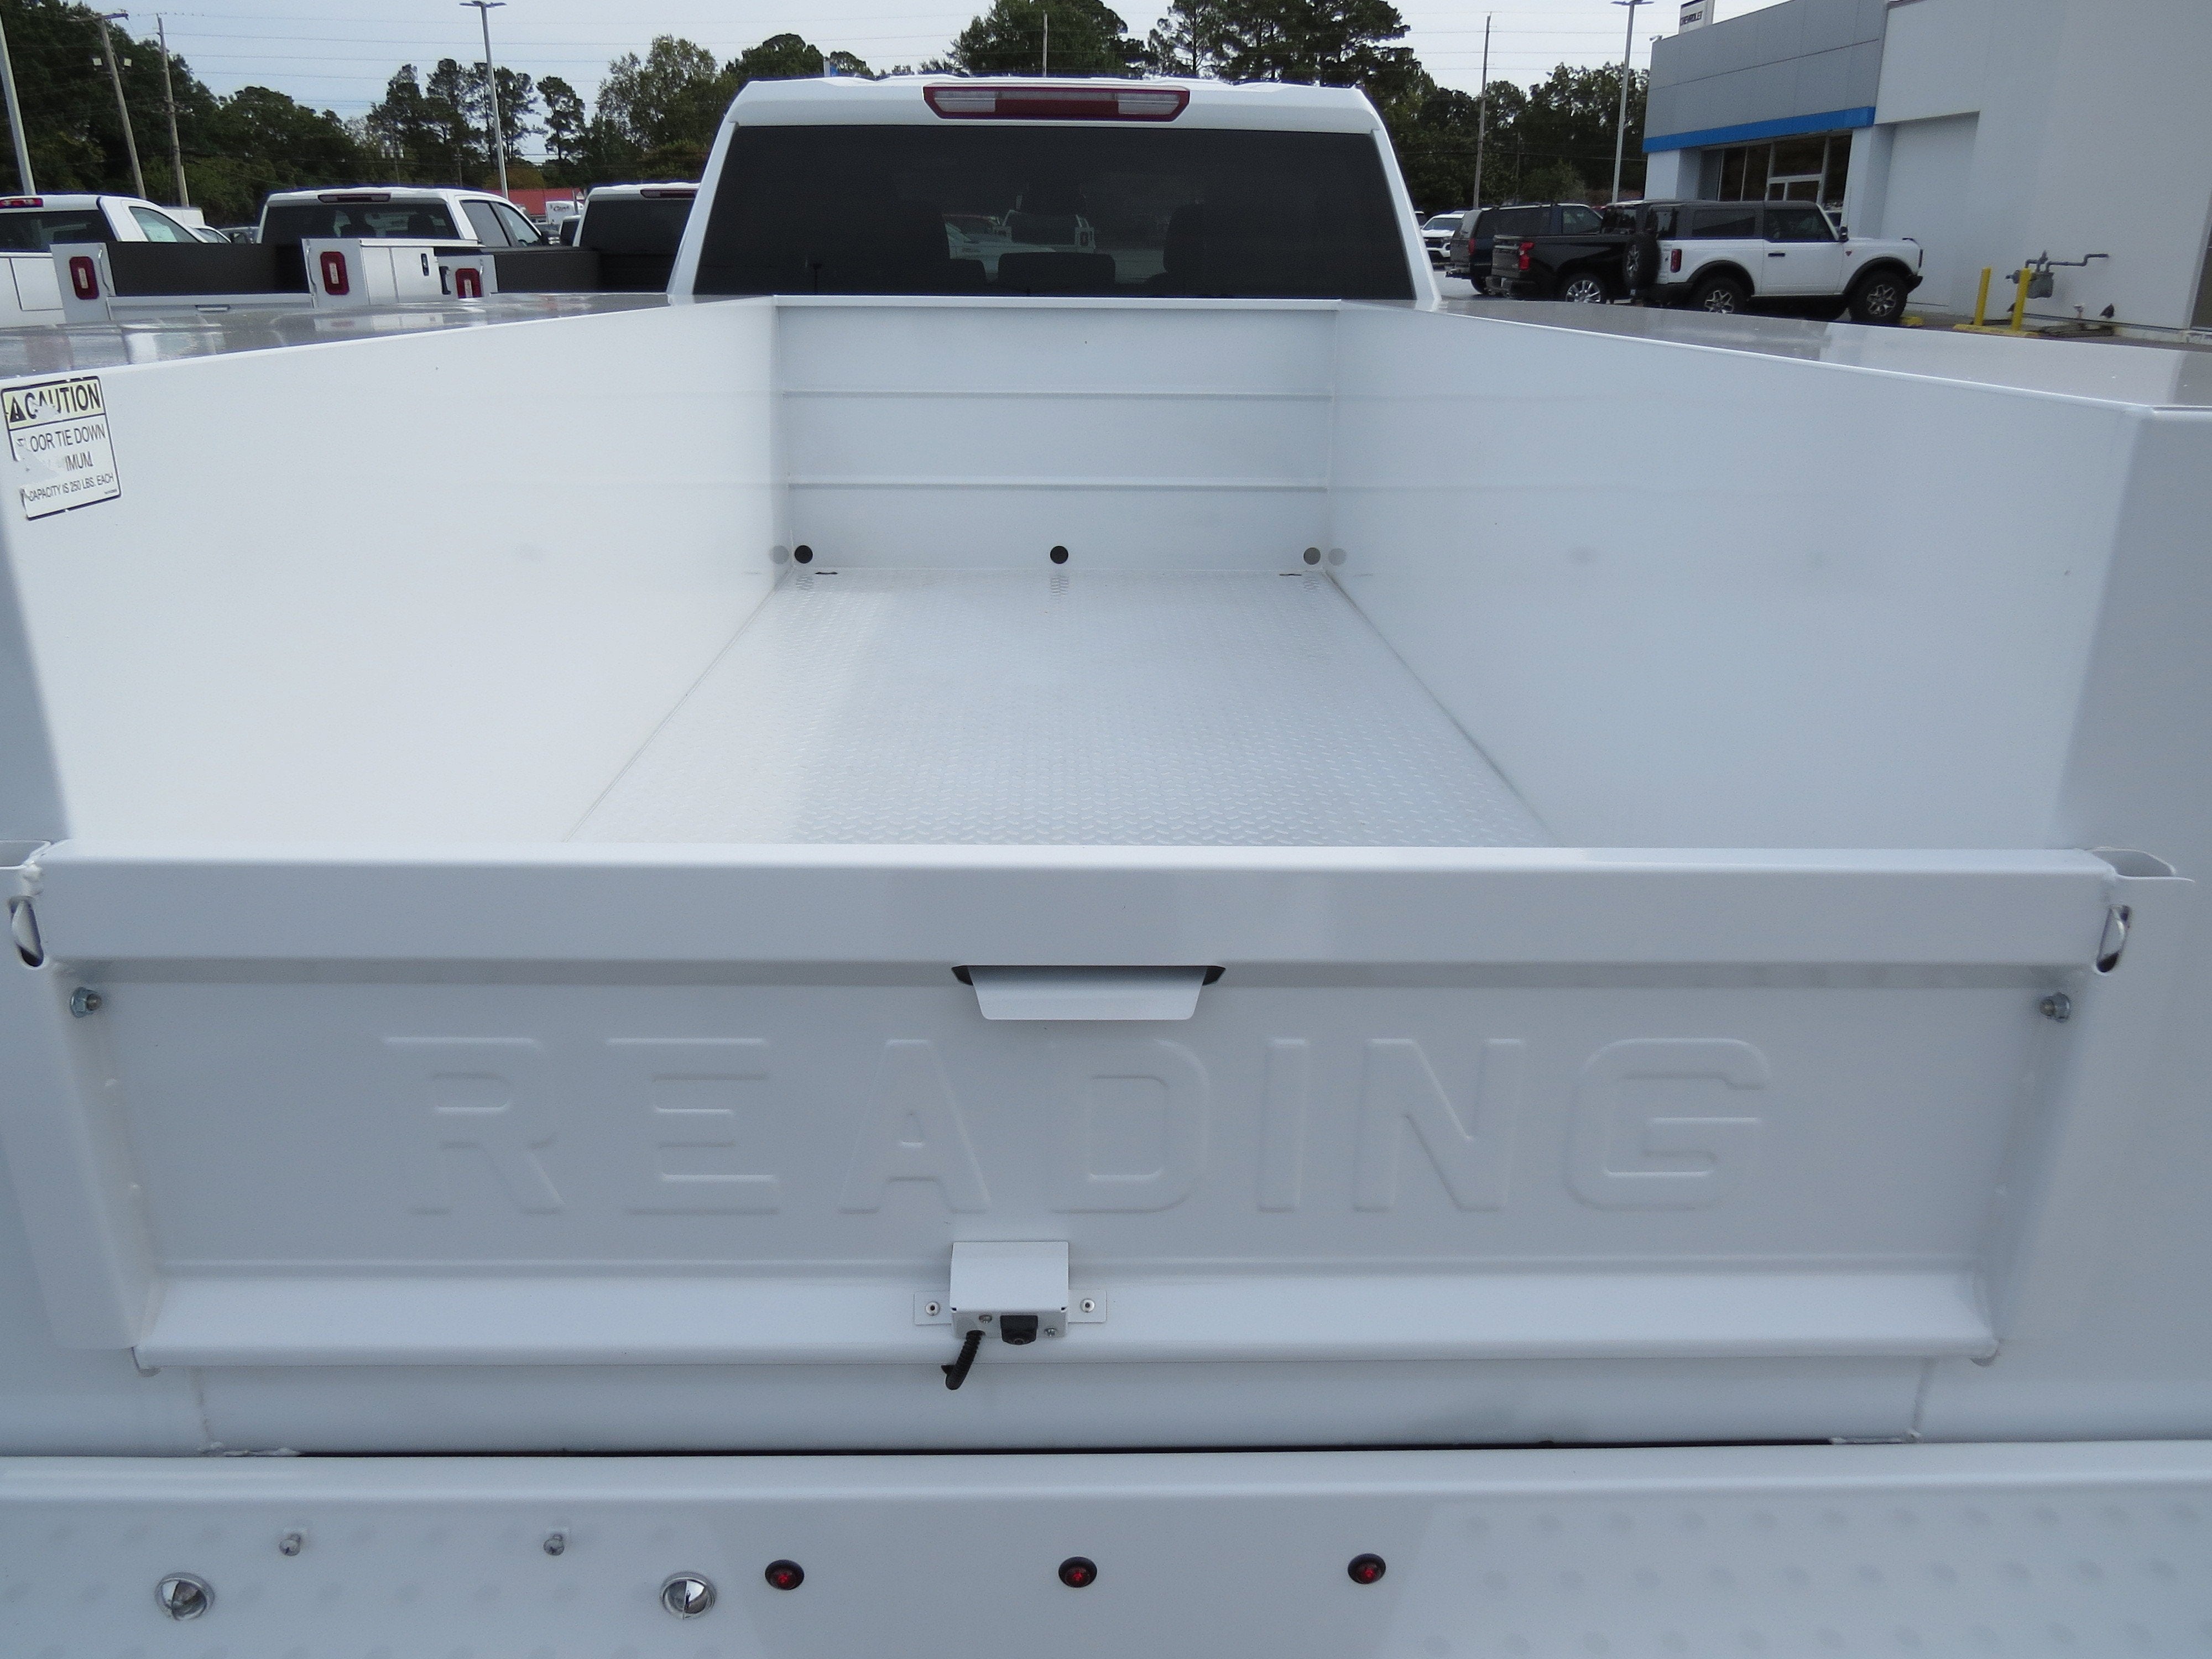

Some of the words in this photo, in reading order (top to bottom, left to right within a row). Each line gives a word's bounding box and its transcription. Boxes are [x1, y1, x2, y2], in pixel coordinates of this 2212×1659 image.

[17, 433, 56, 452] OOR
[55, 429, 74, 447] TIE
[74, 423, 106, 444] DOWN
[28, 484, 62, 502] CAPACITY
[62, 482, 70, 494] IS
[70, 479, 82, 492] 250
[96, 472, 114, 486] EACH
[382, 1035, 1771, 1217] READING
